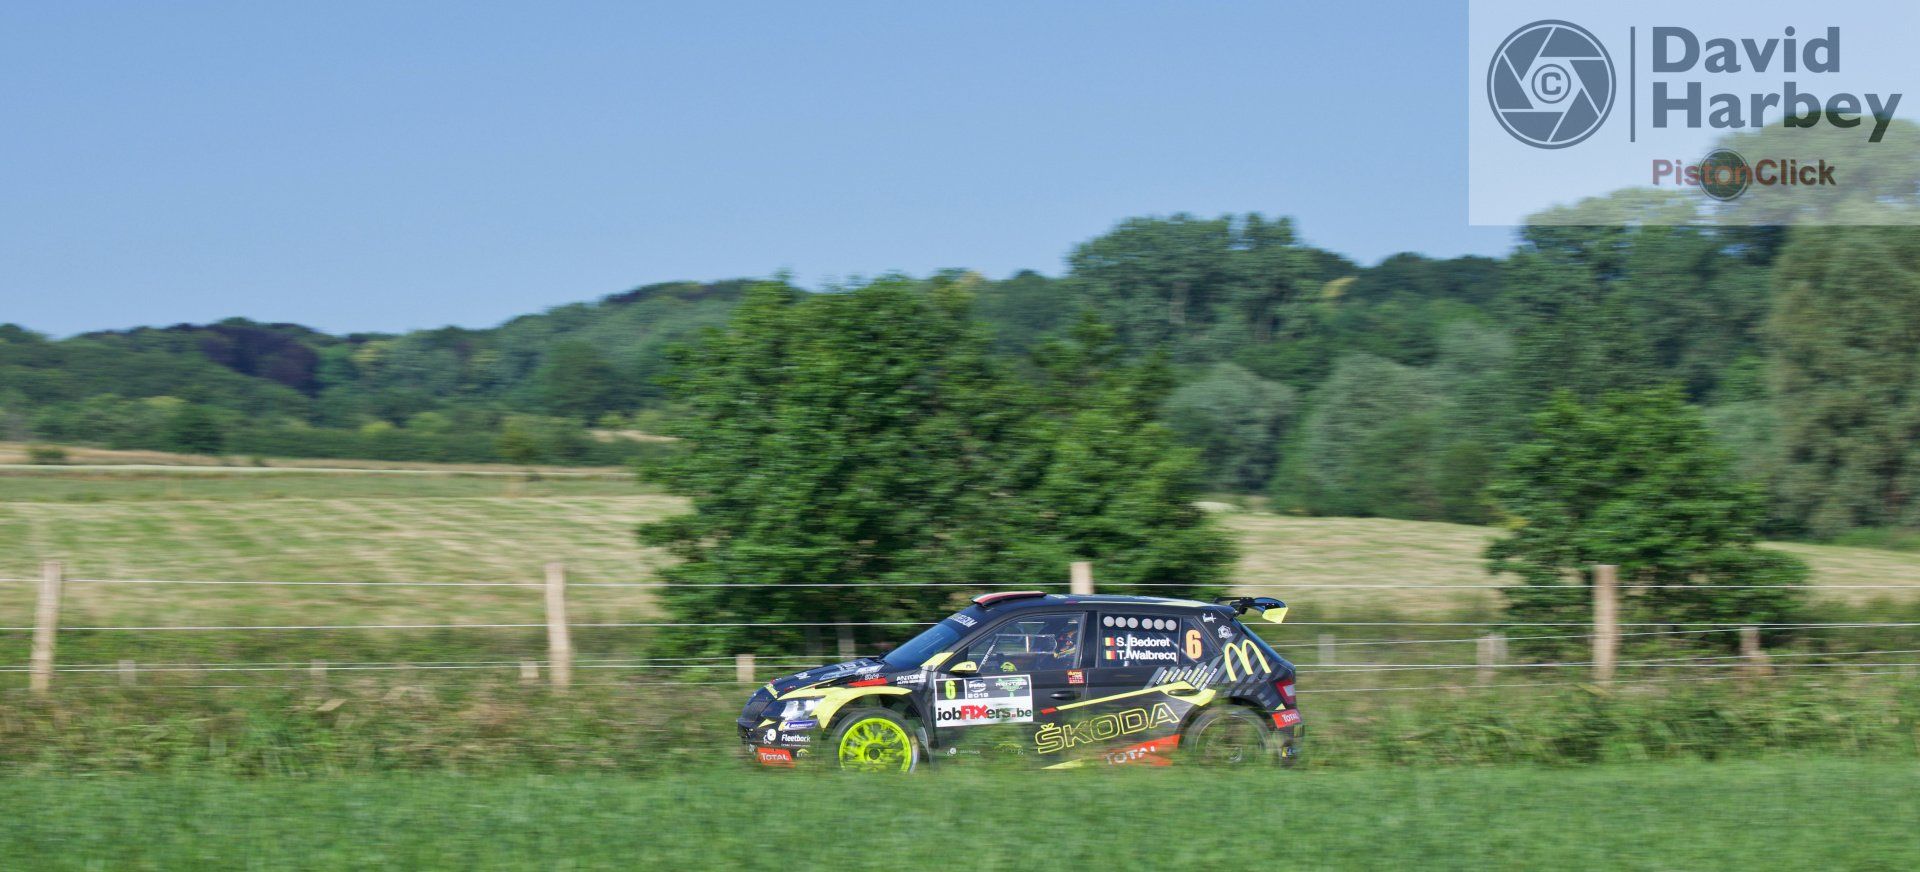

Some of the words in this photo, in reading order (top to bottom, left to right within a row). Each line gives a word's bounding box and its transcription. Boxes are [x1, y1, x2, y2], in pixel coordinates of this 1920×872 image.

[1116, 637, 1127, 647] S.
[1130, 637, 1171, 647] Bedoret
[1186, 629, 1203, 659] 6
[1117, 650, 1127, 660] T.
[1128, 650, 1177, 662] Walbrecq
[945, 680, 956, 700] 6
[937, 705, 1032, 721] jobFIXers.be
[761, 752, 790, 761] TOTAL
